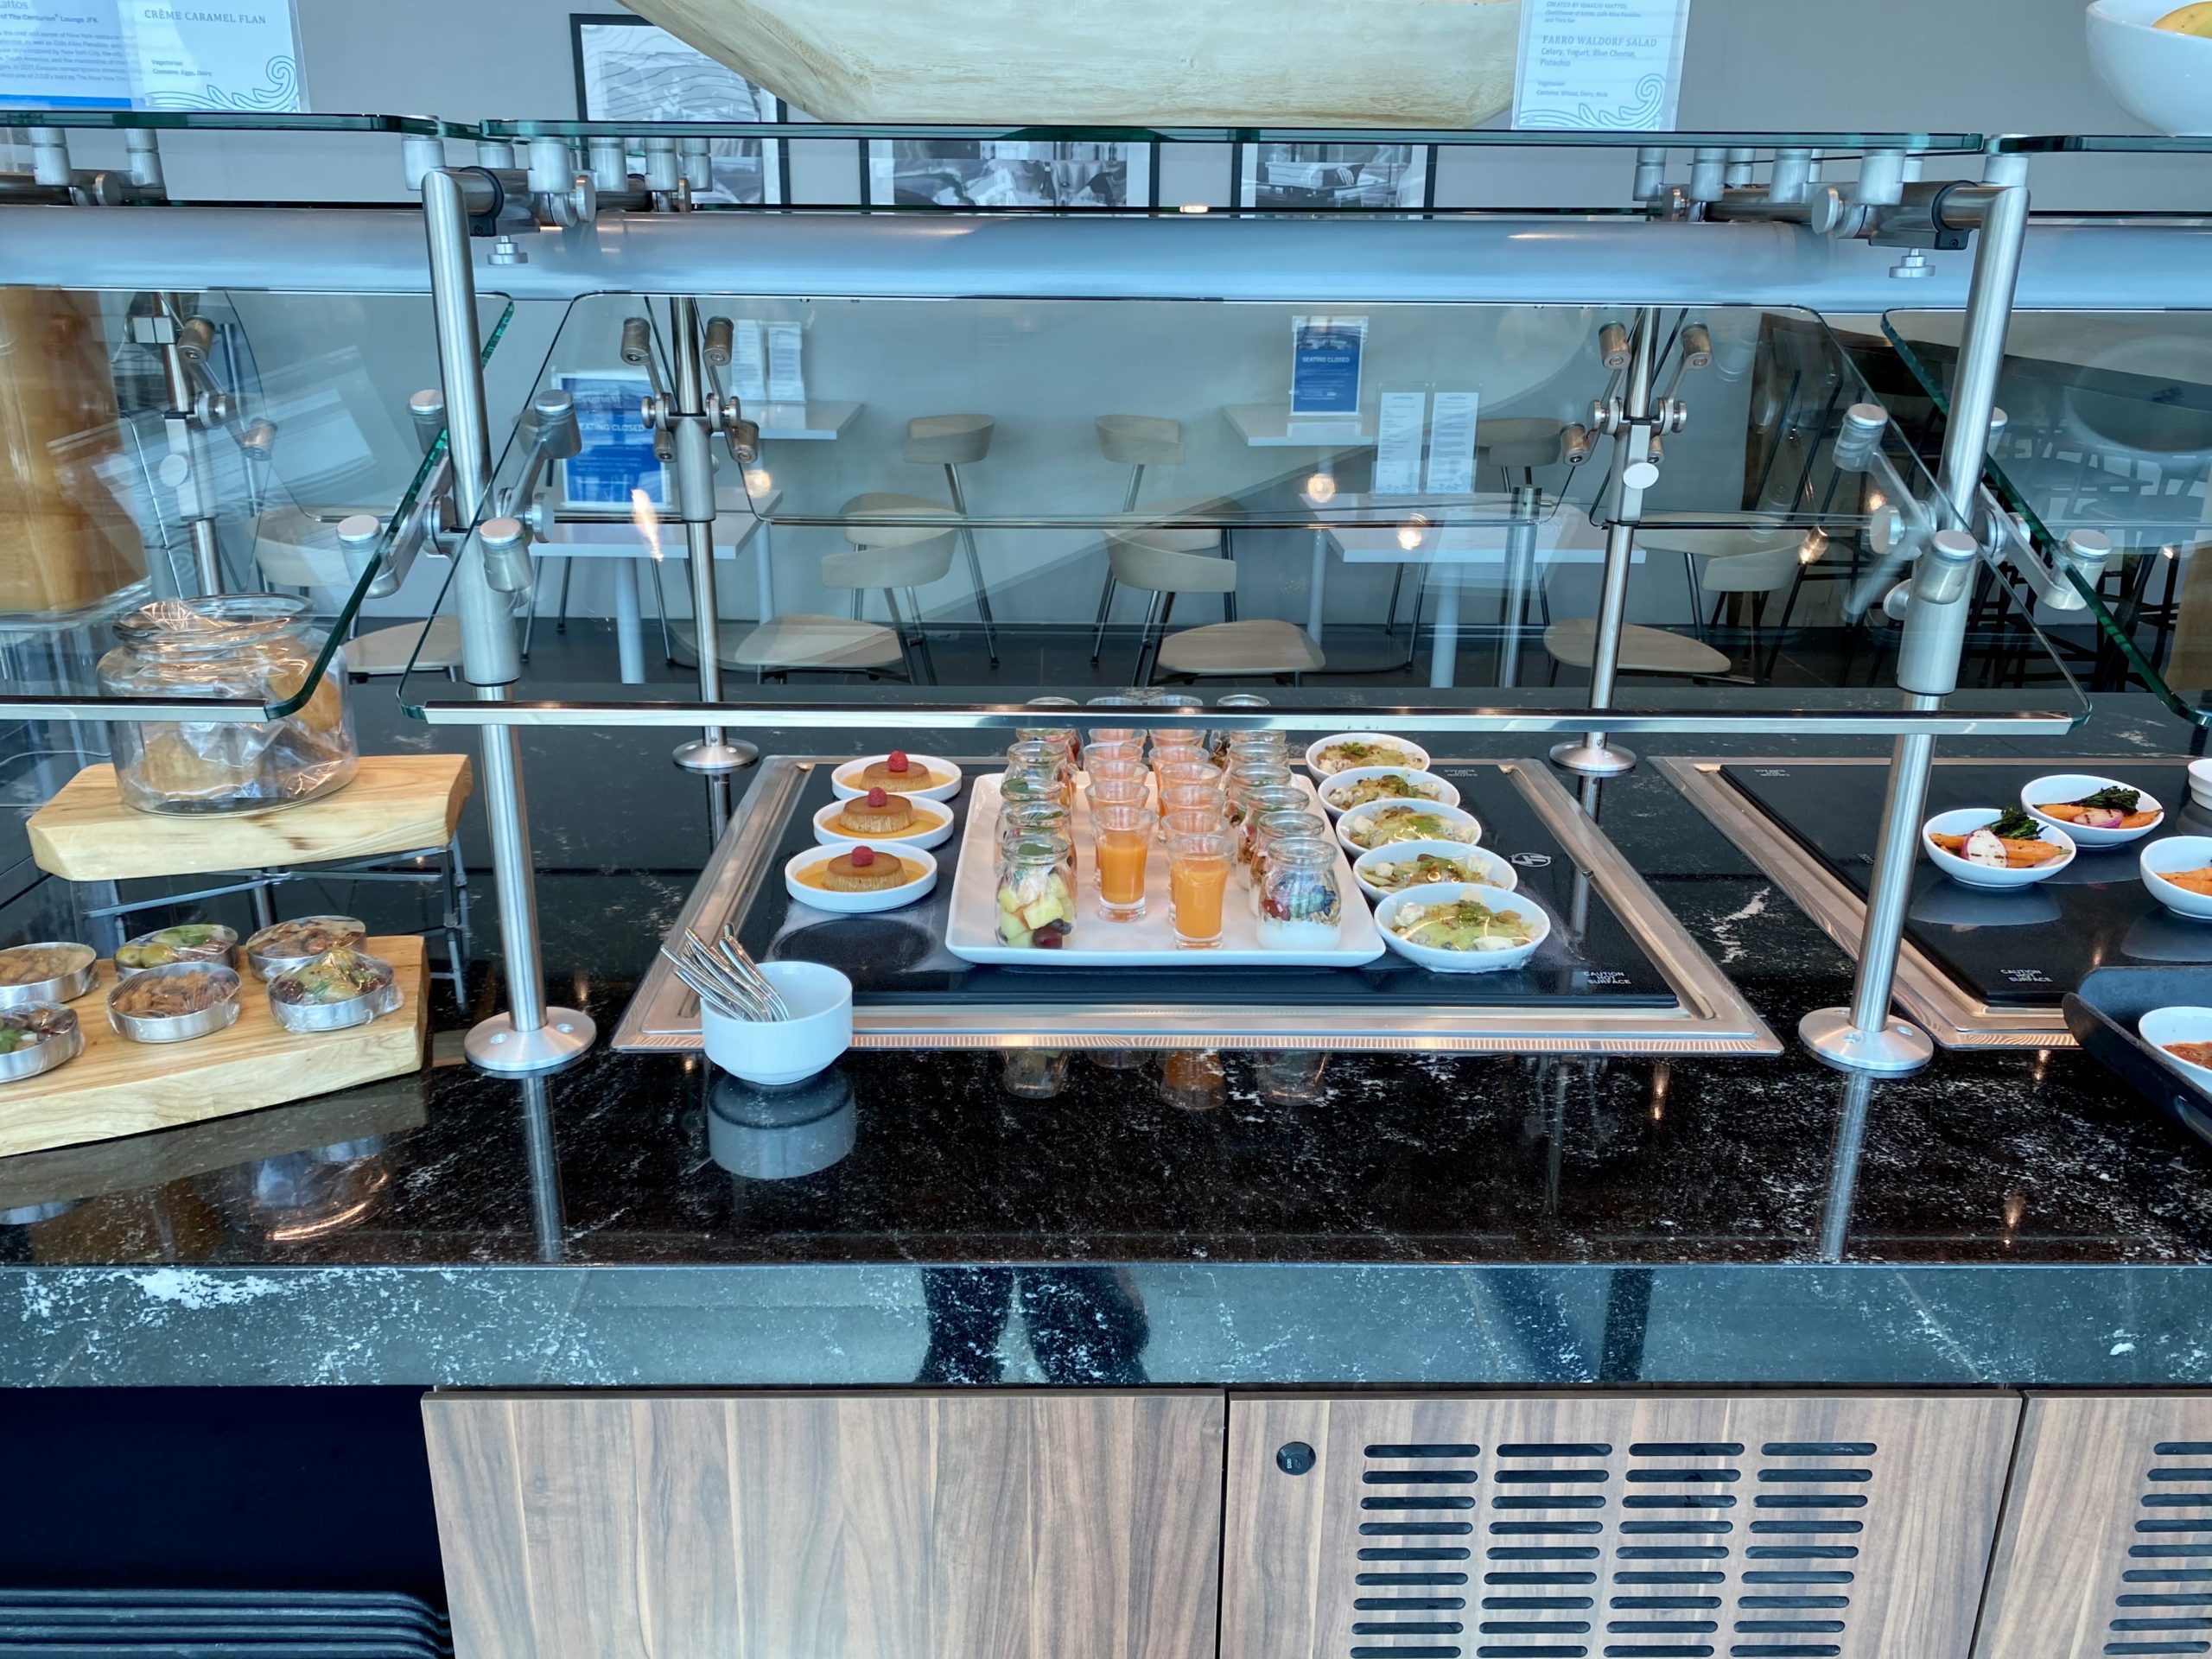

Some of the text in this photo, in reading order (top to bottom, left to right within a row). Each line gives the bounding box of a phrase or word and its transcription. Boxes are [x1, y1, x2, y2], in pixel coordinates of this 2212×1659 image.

[0, 0, 29, 10] attos
[144, 9, 266, 24] CRÈME CARAMEL FLAN
[1542, 35, 1657, 47] FARRO WALDORF SALAD
[1541, 48, 1565, 56] Celery,
[1567, 48, 1591, 58] Yogurt,
[1610, 49, 1637, 59] Cheese,
